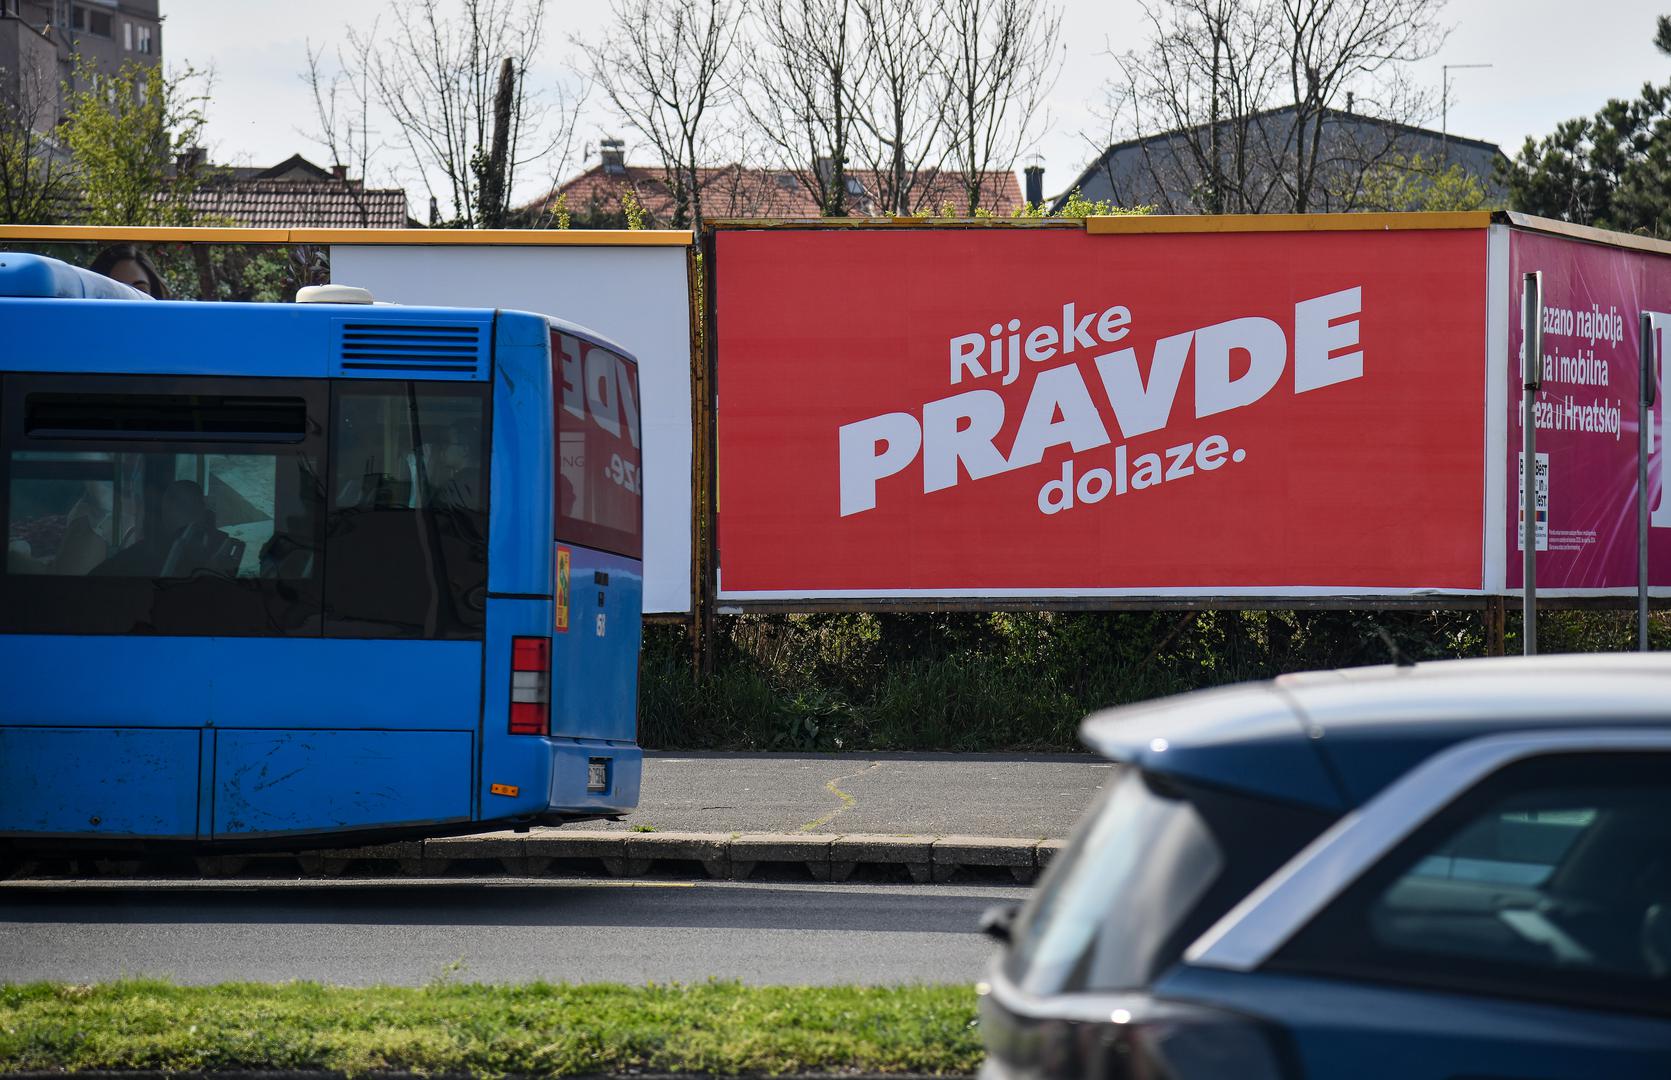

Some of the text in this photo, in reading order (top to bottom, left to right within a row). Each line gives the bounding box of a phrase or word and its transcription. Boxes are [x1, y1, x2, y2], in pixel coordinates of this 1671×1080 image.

[950, 302, 1132, 386] Rijeke
[1576, 304, 1624, 348] najbolja
[1561, 349, 1608, 386] mobilna
[839, 286, 1363, 517] PRAVDE
[1556, 402, 1562, 430] u
[1565, 395, 1621, 441] Hrvatskoj
[1037, 434, 1247, 515] dolaze.
